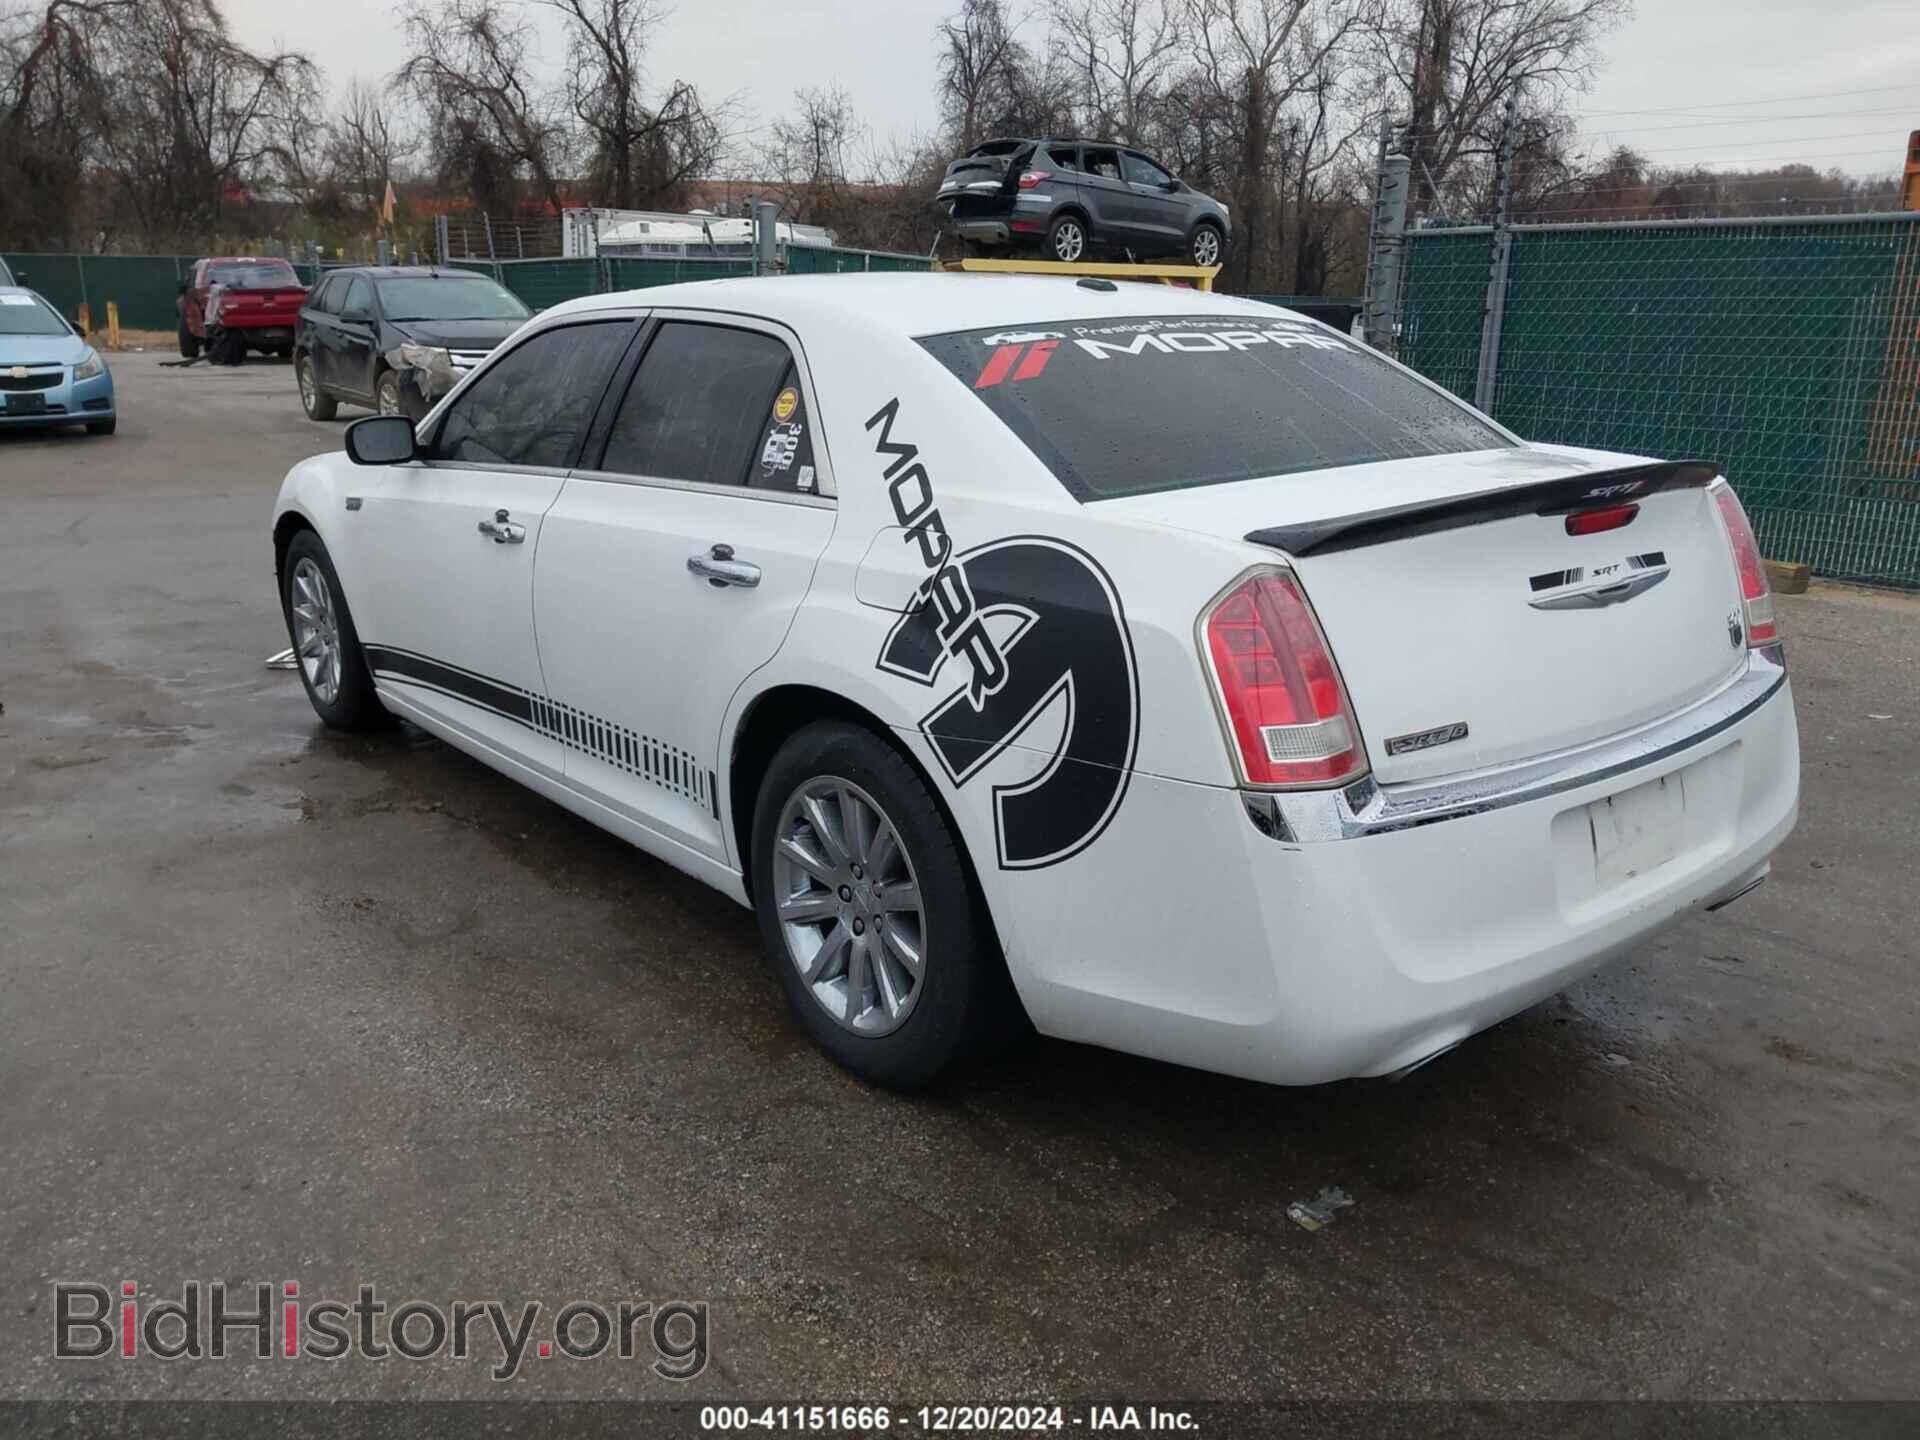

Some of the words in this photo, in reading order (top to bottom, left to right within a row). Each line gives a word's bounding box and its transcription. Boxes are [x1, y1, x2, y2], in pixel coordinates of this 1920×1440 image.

[1072, 329, 1361, 360] MOPAR
[865, 397, 1008, 711] MOPAR
[1592, 564, 1621, 578] SRT
